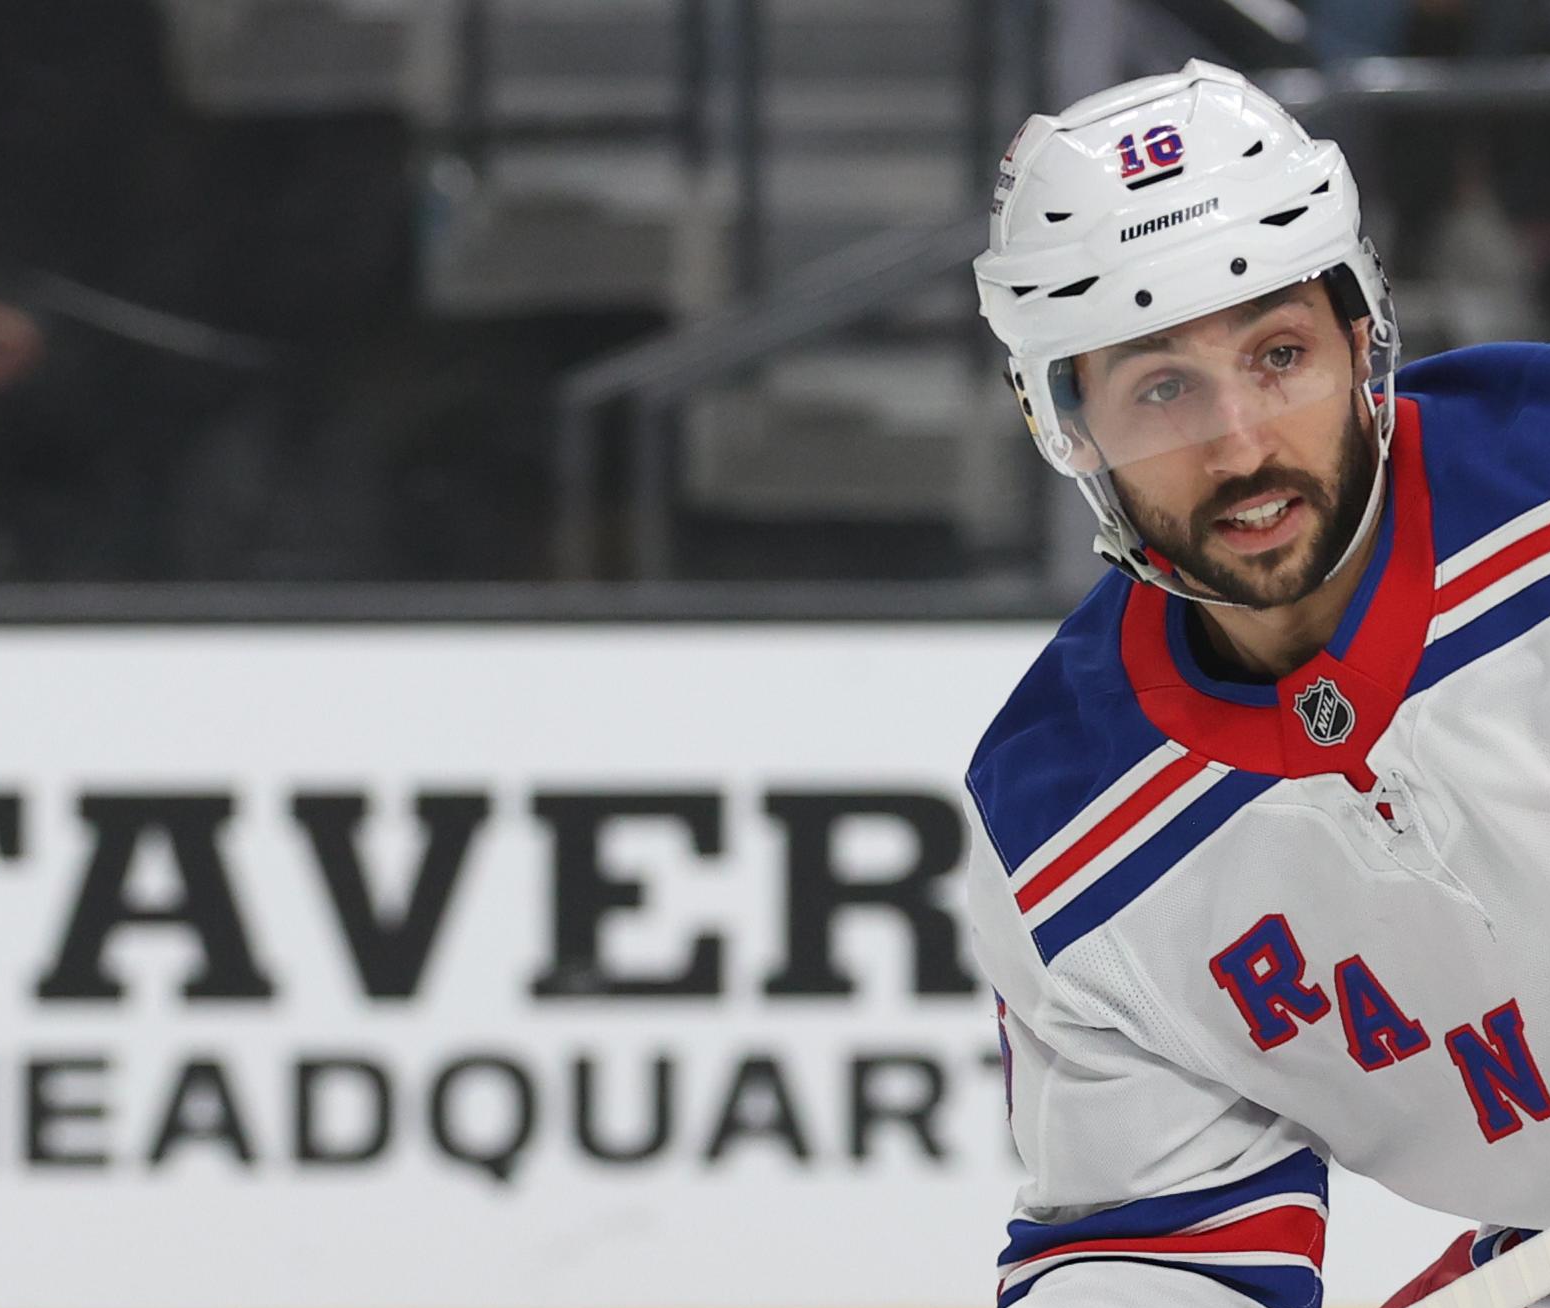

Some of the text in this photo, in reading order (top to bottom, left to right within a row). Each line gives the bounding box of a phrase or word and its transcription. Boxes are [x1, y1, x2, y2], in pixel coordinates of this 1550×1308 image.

[1116, 125, 1185, 178] 16
[1120, 197, 1219, 243] WARRIOR
[1317, 694, 1334, 736] NHL
